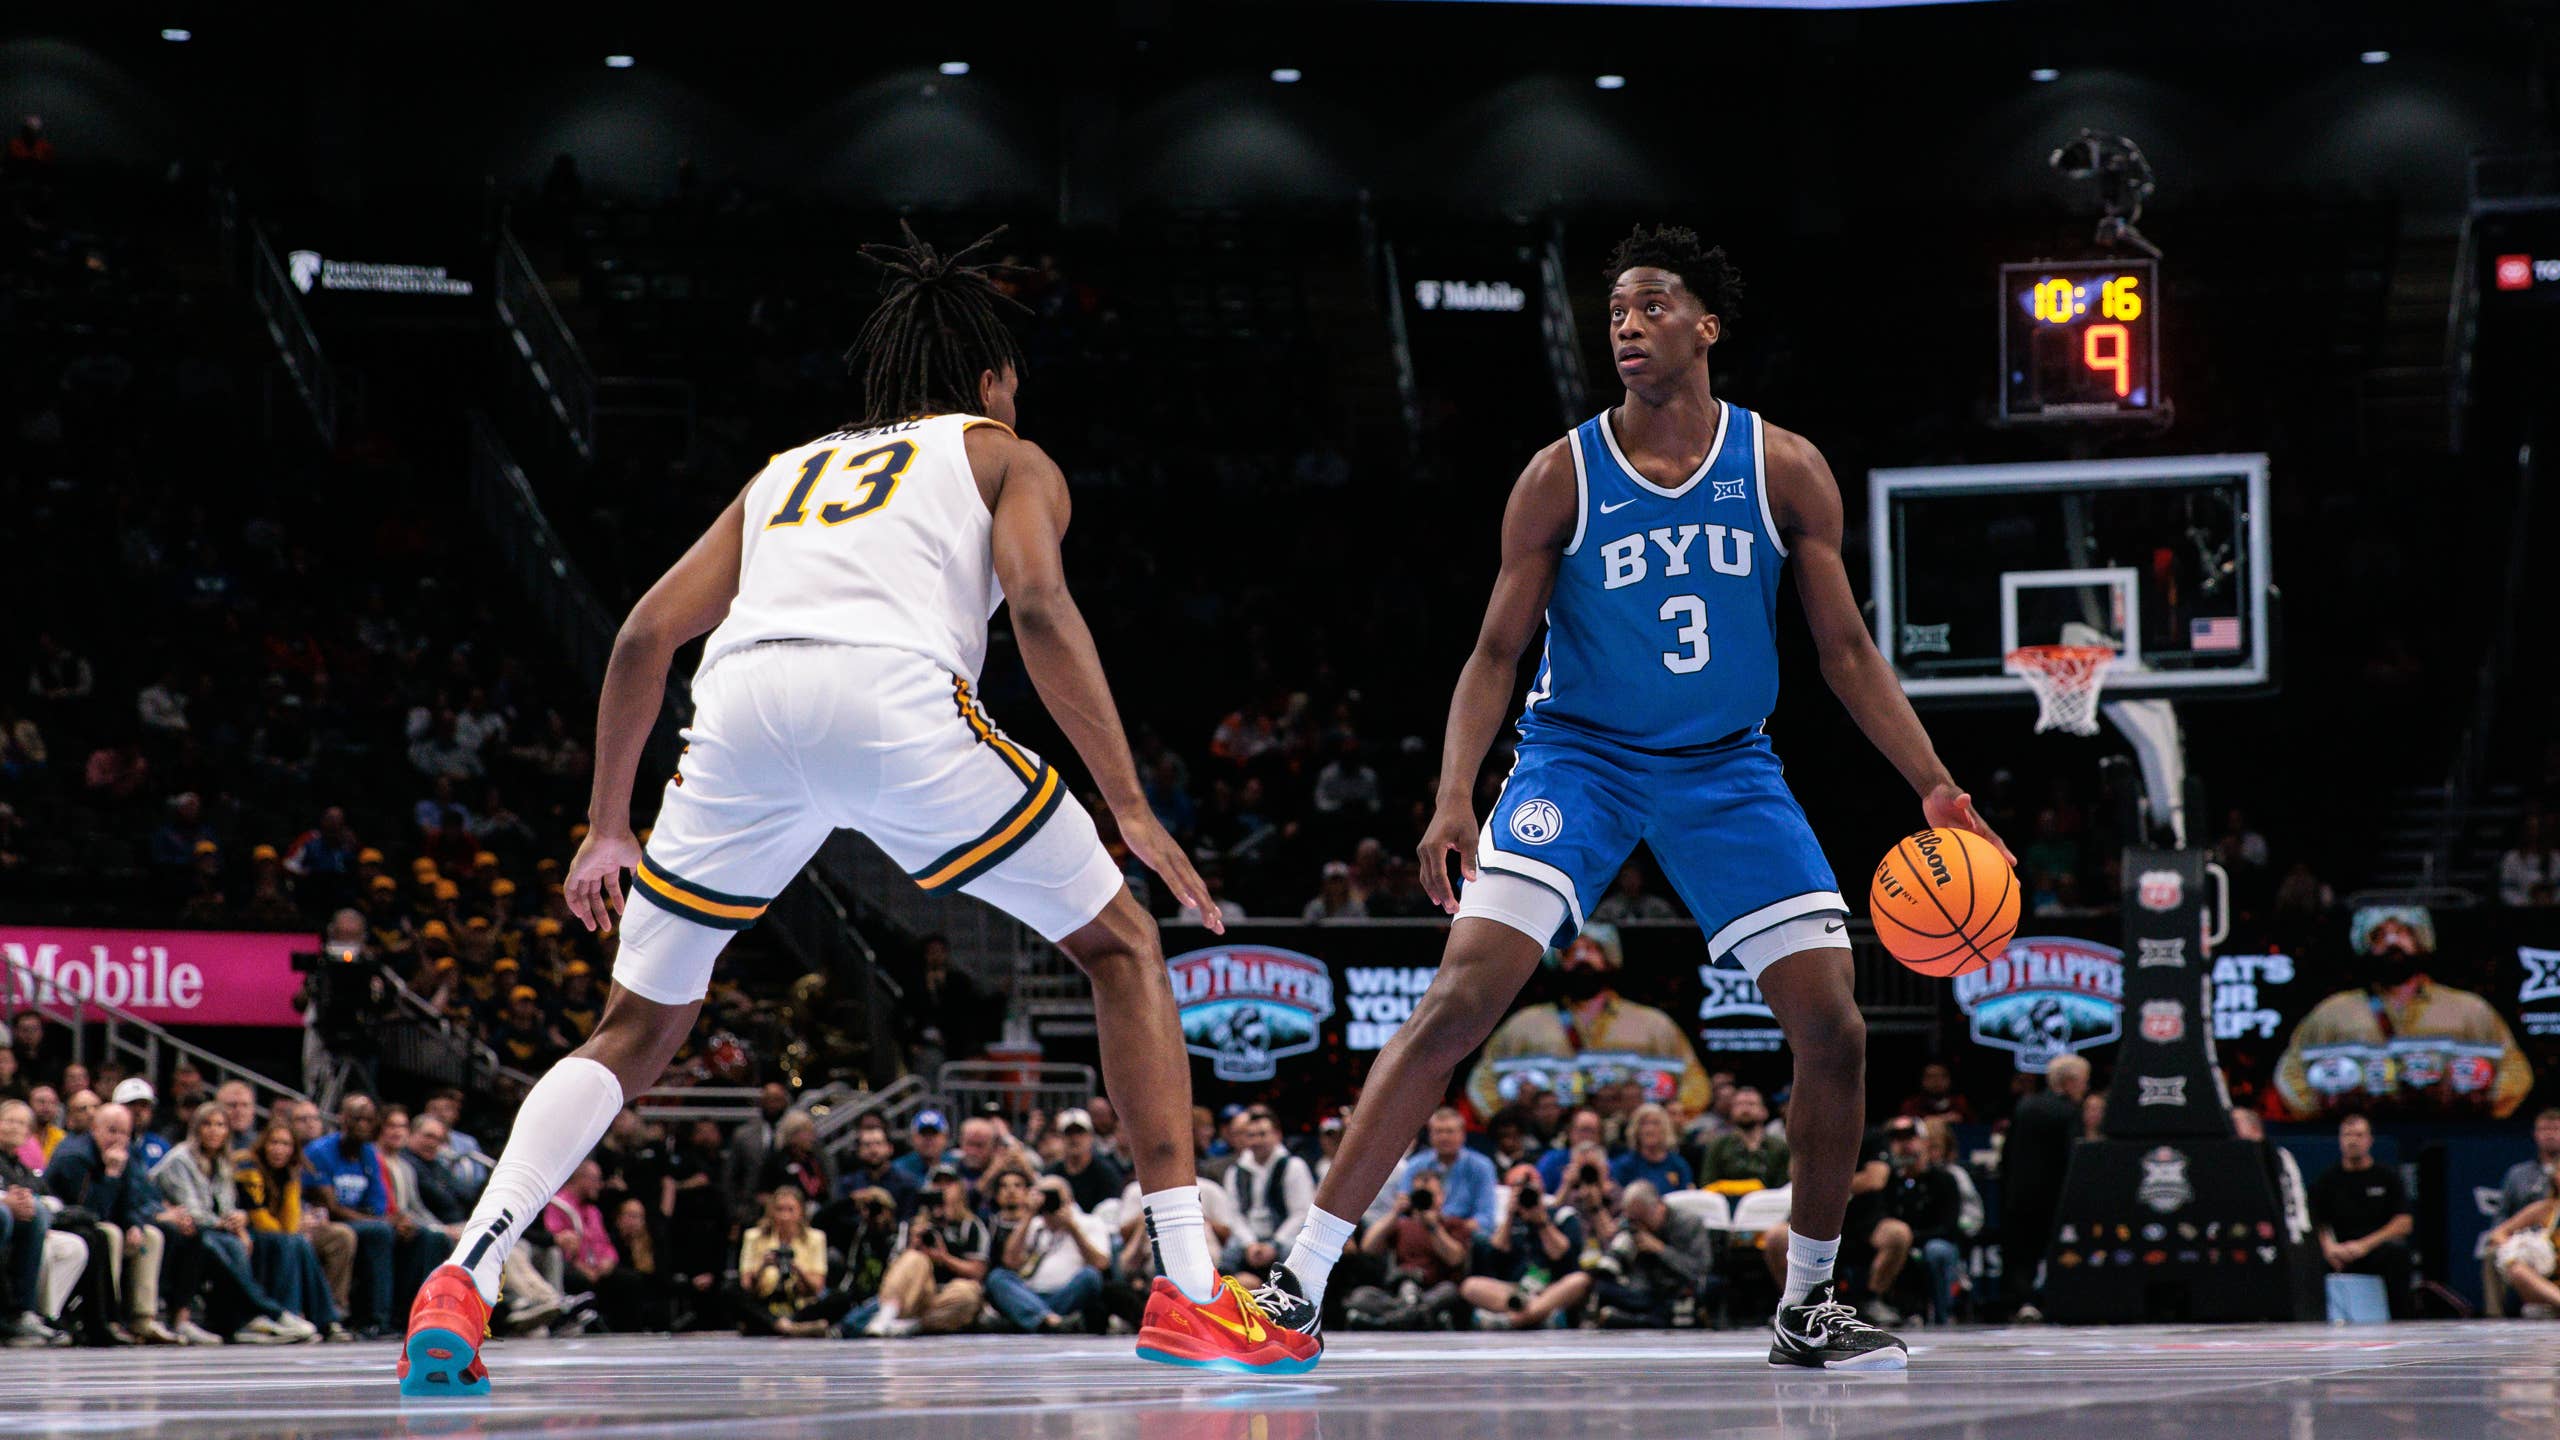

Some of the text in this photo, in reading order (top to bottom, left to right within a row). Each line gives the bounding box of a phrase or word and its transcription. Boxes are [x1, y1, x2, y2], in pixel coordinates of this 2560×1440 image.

[1442, 280, 1525, 311] Mobile
[2034, 276, 2142, 323] 10:16
[2084, 324, 2129, 397] 9
[764, 438, 920, 531] 13
[1714, 481, 1743, 499] XII
[1600, 523, 1754, 590] BYU
[1659, 594, 1711, 674] 3
[0, 943, 204, 1008] Mobile
[1168, 965, 1211, 1004] LD
[1345, 967, 1440, 993] WHA
